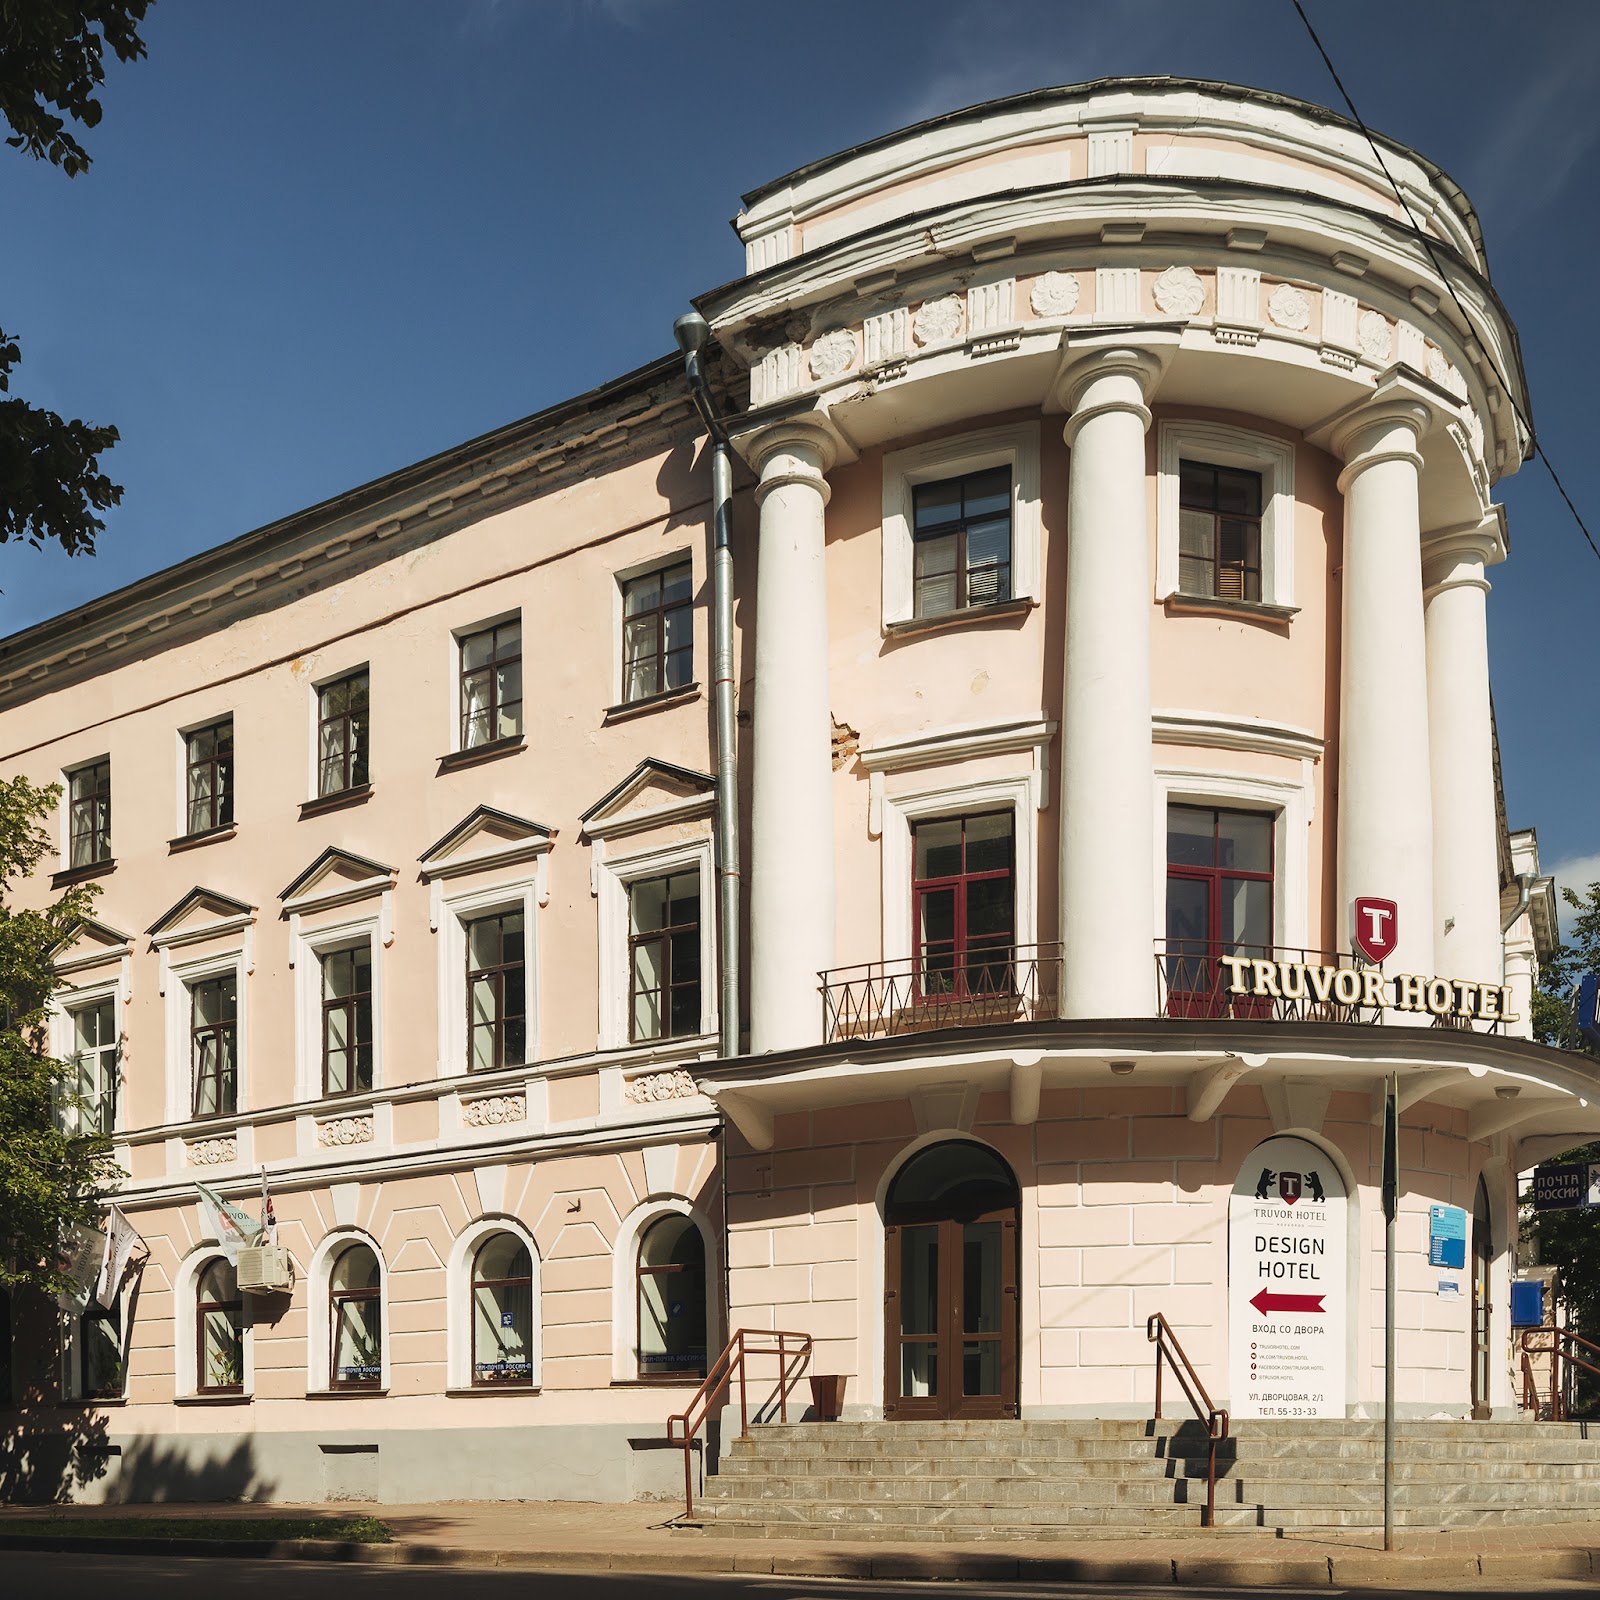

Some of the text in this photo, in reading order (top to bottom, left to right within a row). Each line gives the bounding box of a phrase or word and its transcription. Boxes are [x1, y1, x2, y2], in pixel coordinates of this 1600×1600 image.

[1362, 906, 1391, 944] T
[1221, 955, 1520, 1022] TRUVOR HOTEL
[1537, 1174, 1579, 1188] ПОЧТА
[1537, 1187, 1580, 1200] РОССИИ
[1253, 1208, 1327, 1221] TRUVOR HOTEL
[1255, 1235, 1324, 1255] DESIGN
[1259, 1261, 1320, 1280] HOTEL
[1252, 1324, 1325, 1335] ВХОД СО ДВОРА
[1248, 1393, 1324, 1402] УЛ. ДВОРЦОВАЯ, 2/1
[1258, 1407, 1317, 1416] ТЕЛ. 55-33-33
